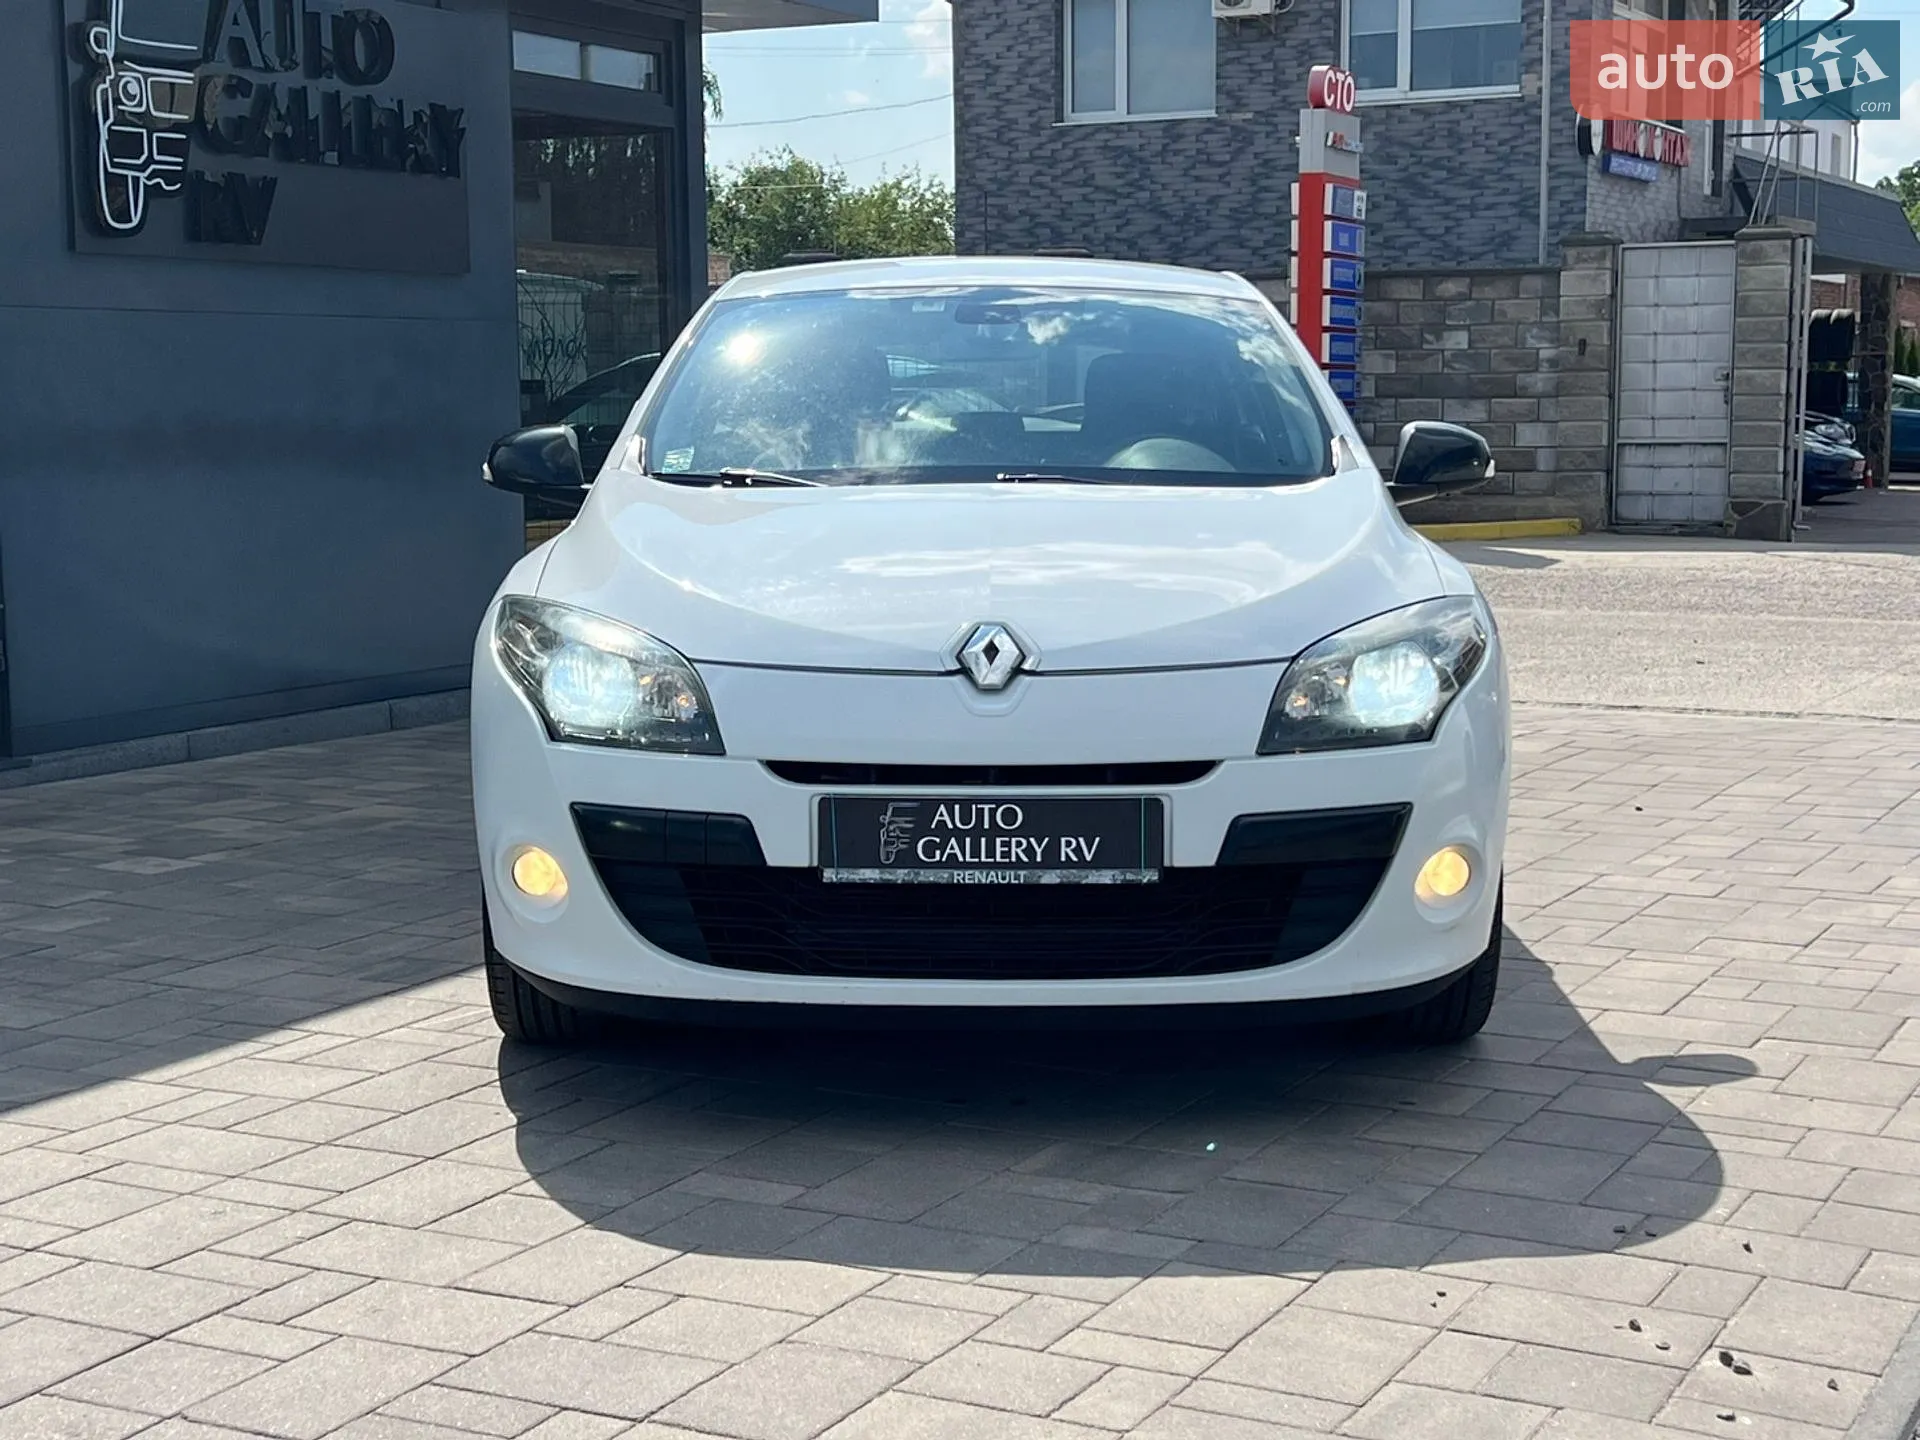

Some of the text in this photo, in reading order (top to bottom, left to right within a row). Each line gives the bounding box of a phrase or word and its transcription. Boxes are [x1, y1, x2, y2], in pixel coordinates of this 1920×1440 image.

[203, 0, 395, 86] AUTO
[1323, 69, 1356, 113] СТО
[197, 74, 467, 178] GALLERY
[185, 170, 278, 245] RV
[930, 803, 1024, 830] AUTO
[916, 836, 1101, 864] GALLERY RV
[952, 870, 1027, 885] RENAULT
